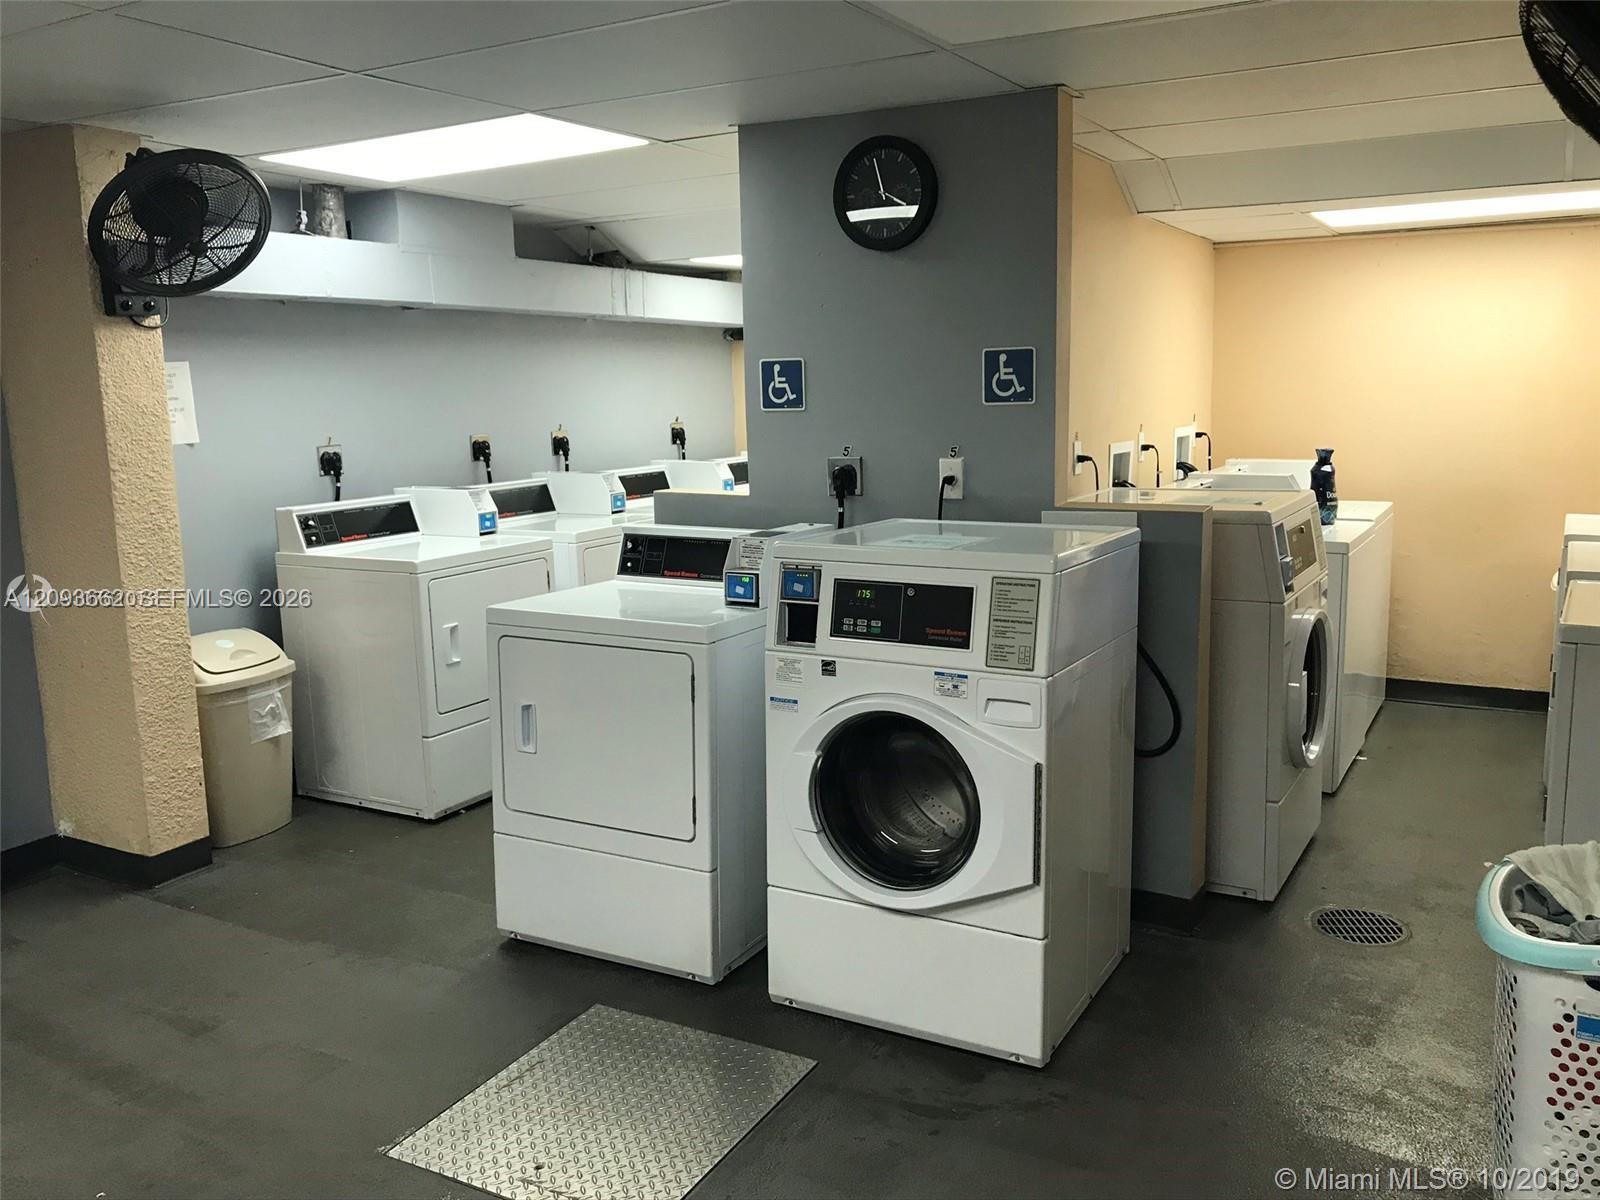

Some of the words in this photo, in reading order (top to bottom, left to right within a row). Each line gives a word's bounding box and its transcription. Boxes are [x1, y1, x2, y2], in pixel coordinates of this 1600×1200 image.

[842, 446, 851, 457] 5
[949, 446, 958, 458] 5
[857, 589, 871, 599] 175
